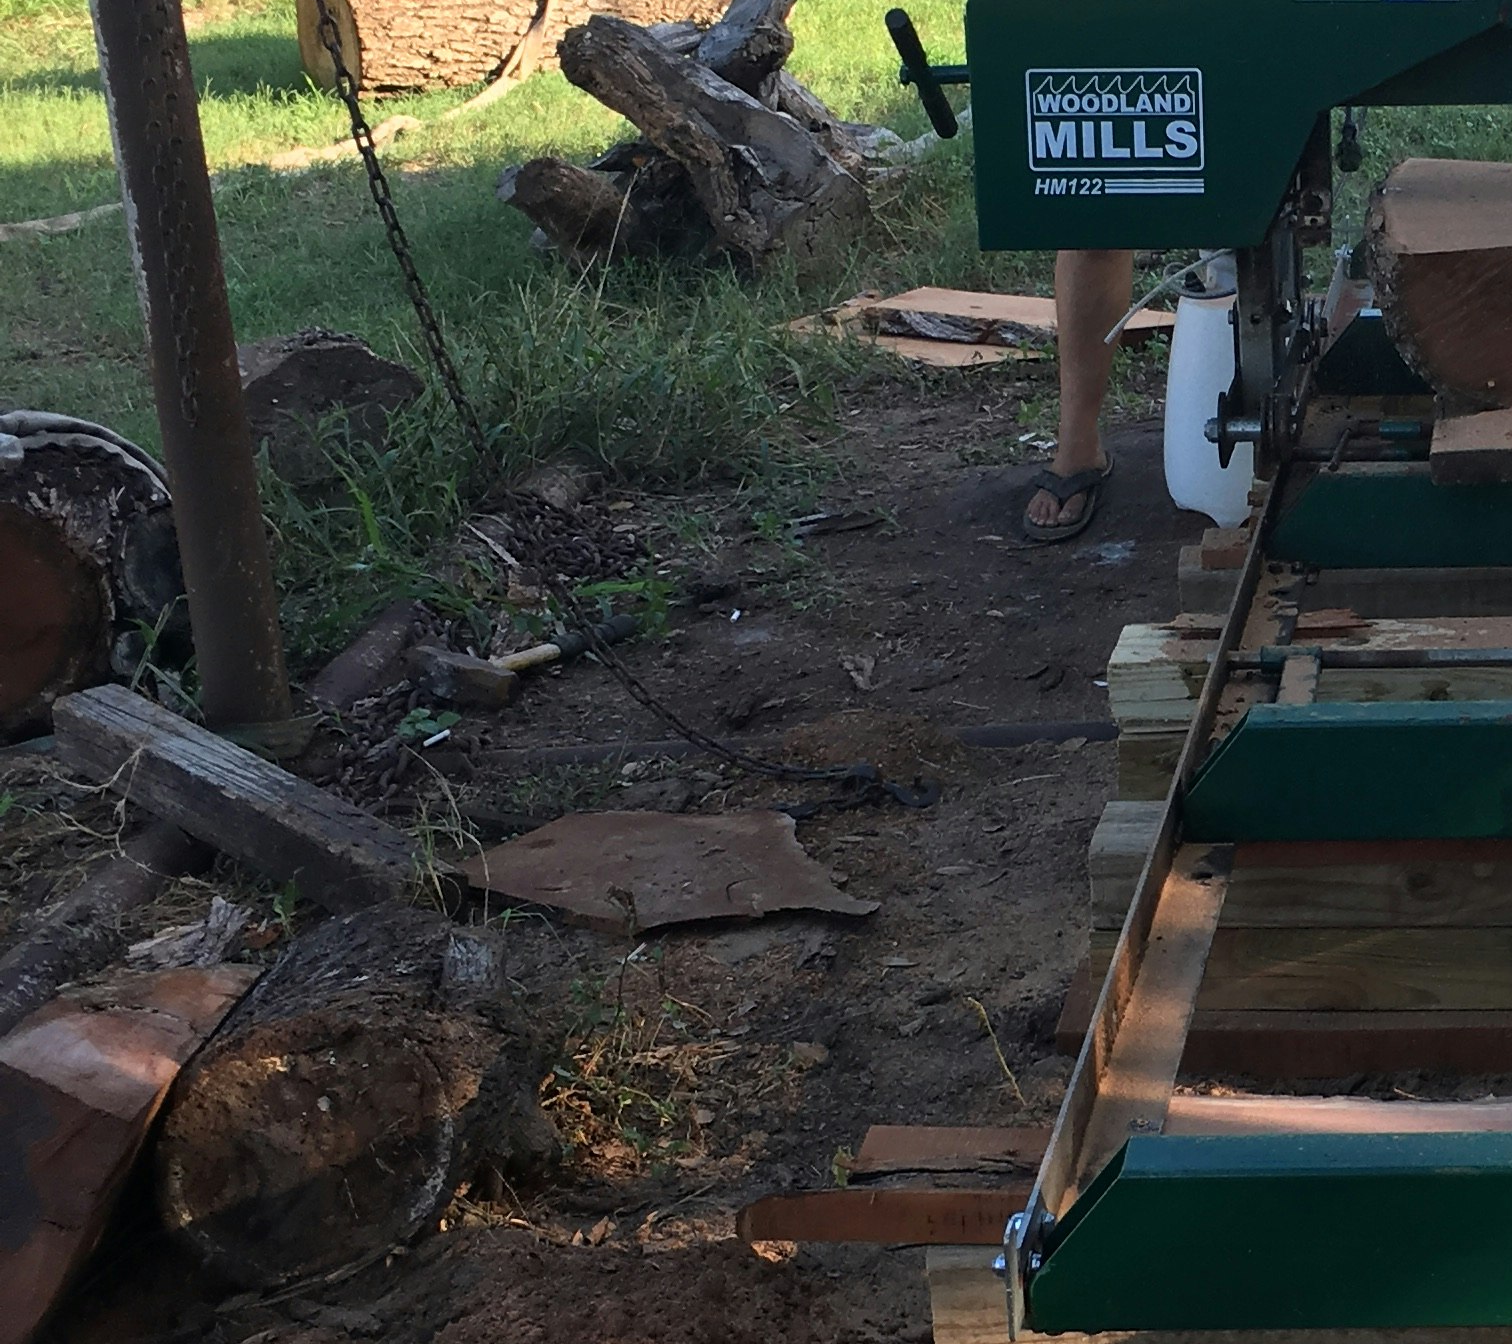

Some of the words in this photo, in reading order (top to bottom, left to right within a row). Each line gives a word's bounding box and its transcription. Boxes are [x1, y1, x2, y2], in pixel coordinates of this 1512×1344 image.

[1037, 93, 1192, 114] WOODLAND
[1034, 119, 1199, 159] MILLS
[1034, 177, 1103, 196] HM122
